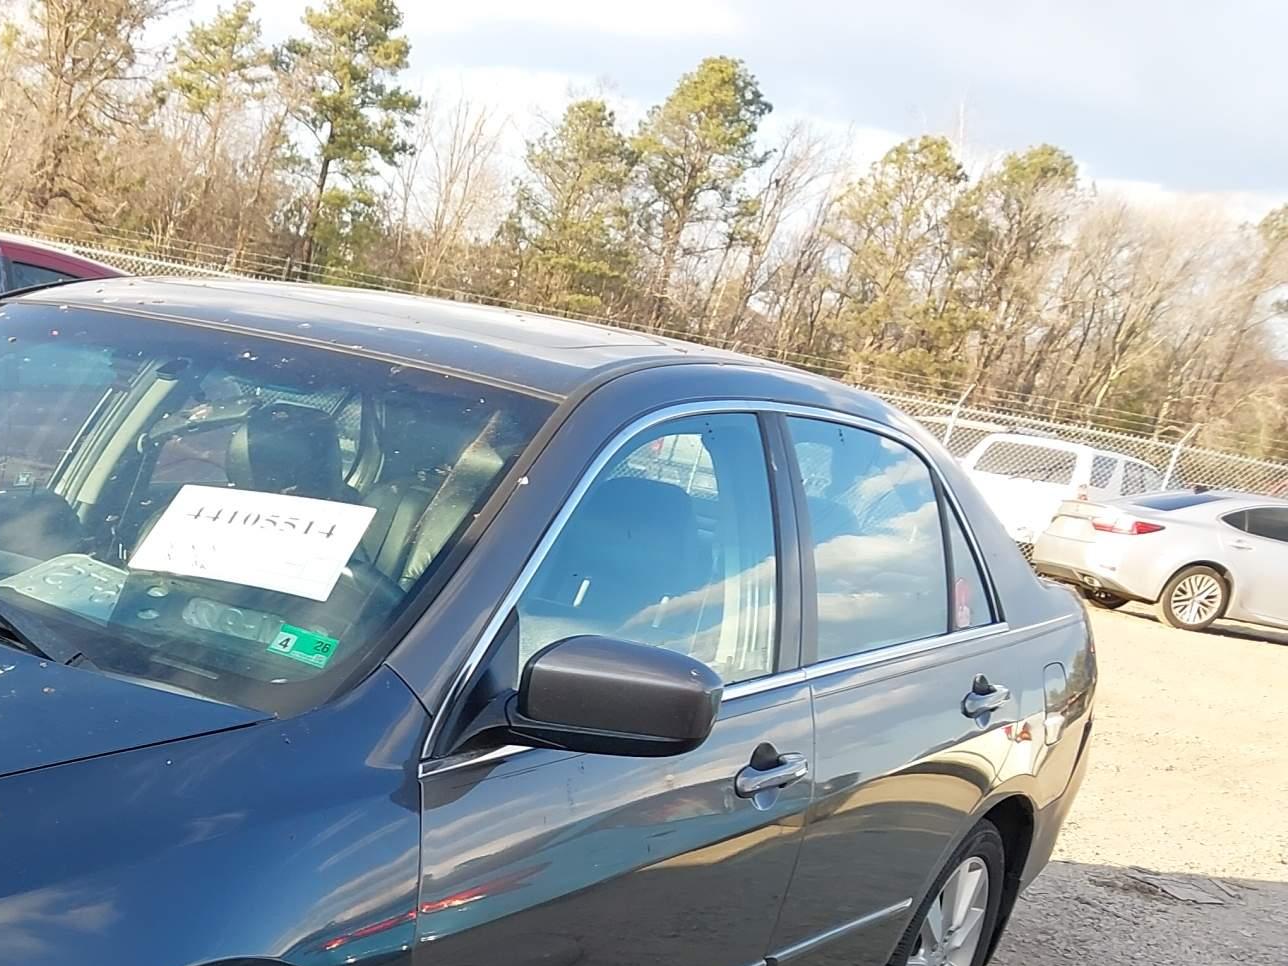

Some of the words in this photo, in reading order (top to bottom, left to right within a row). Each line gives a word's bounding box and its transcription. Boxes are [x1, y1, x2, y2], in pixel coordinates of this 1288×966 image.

[186, 507, 336, 539] 44105514
[278, 637, 292, 649] 4
[313, 640, 332, 654] 26
